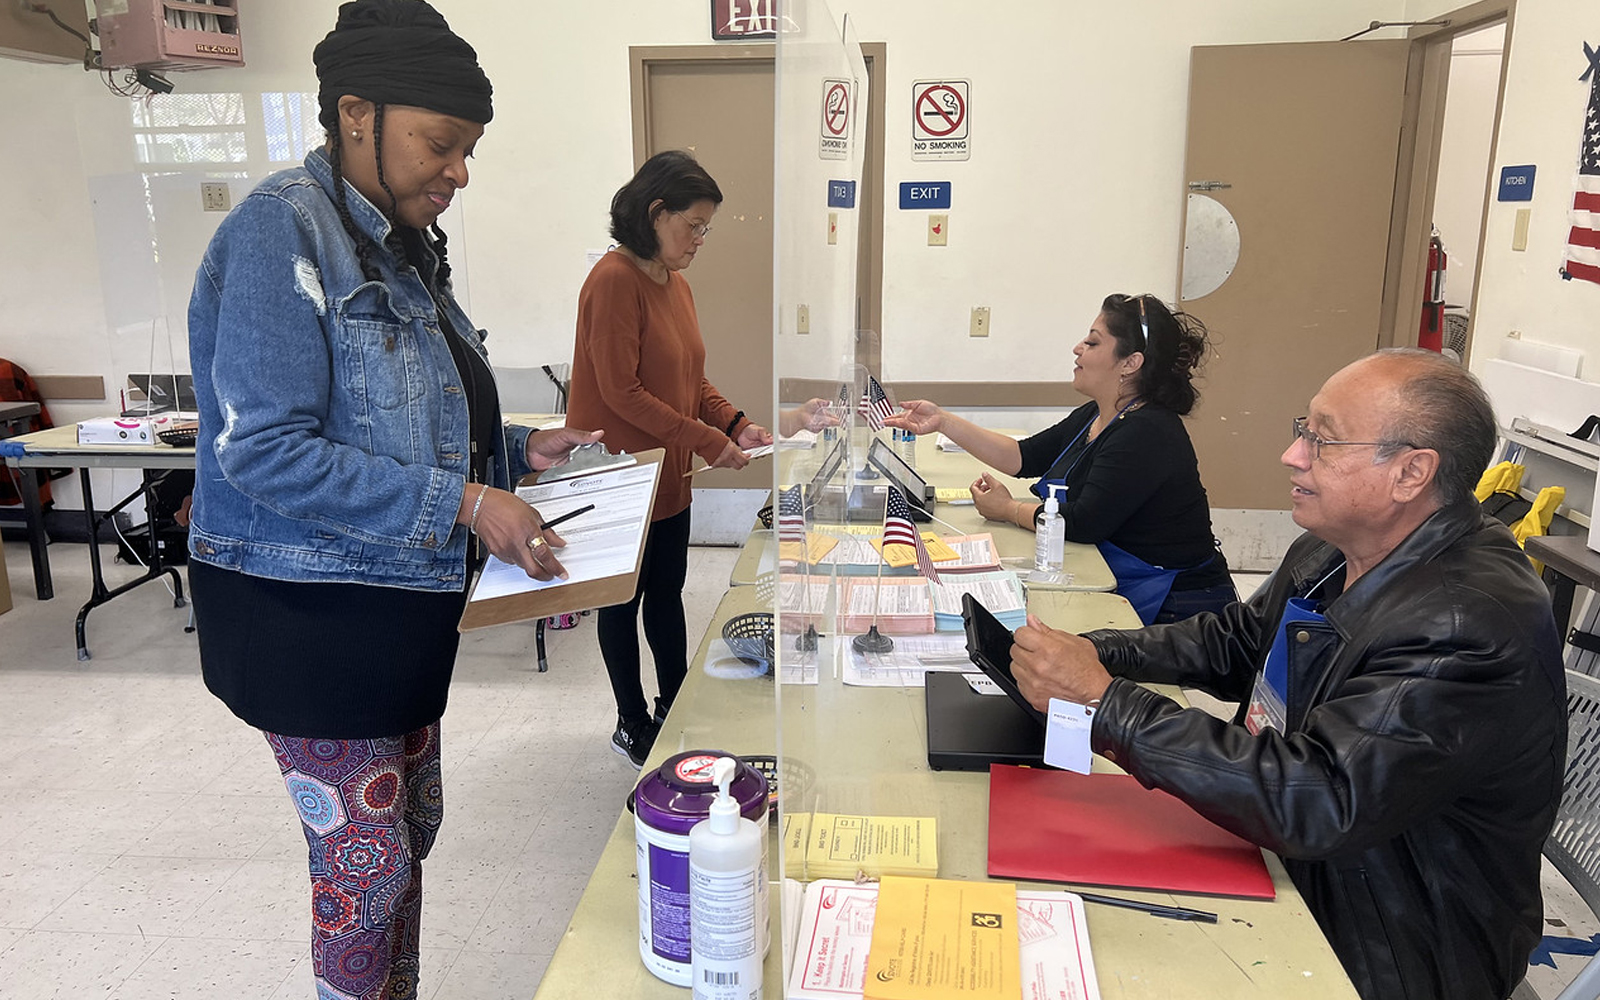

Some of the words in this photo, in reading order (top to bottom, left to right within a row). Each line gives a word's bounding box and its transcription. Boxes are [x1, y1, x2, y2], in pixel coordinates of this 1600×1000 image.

[729, 0, 773, 32] EXI
[197, 44, 237, 54] REZNOR
[914, 142, 927, 151] NO
[929, 141, 967, 150] SMOKING
[1505, 176, 1527, 185] KITCHEN
[910, 187, 940, 200] EXIT
[818, 937, 829, 955] Secret
[813, 962, 827, 977] Keep
